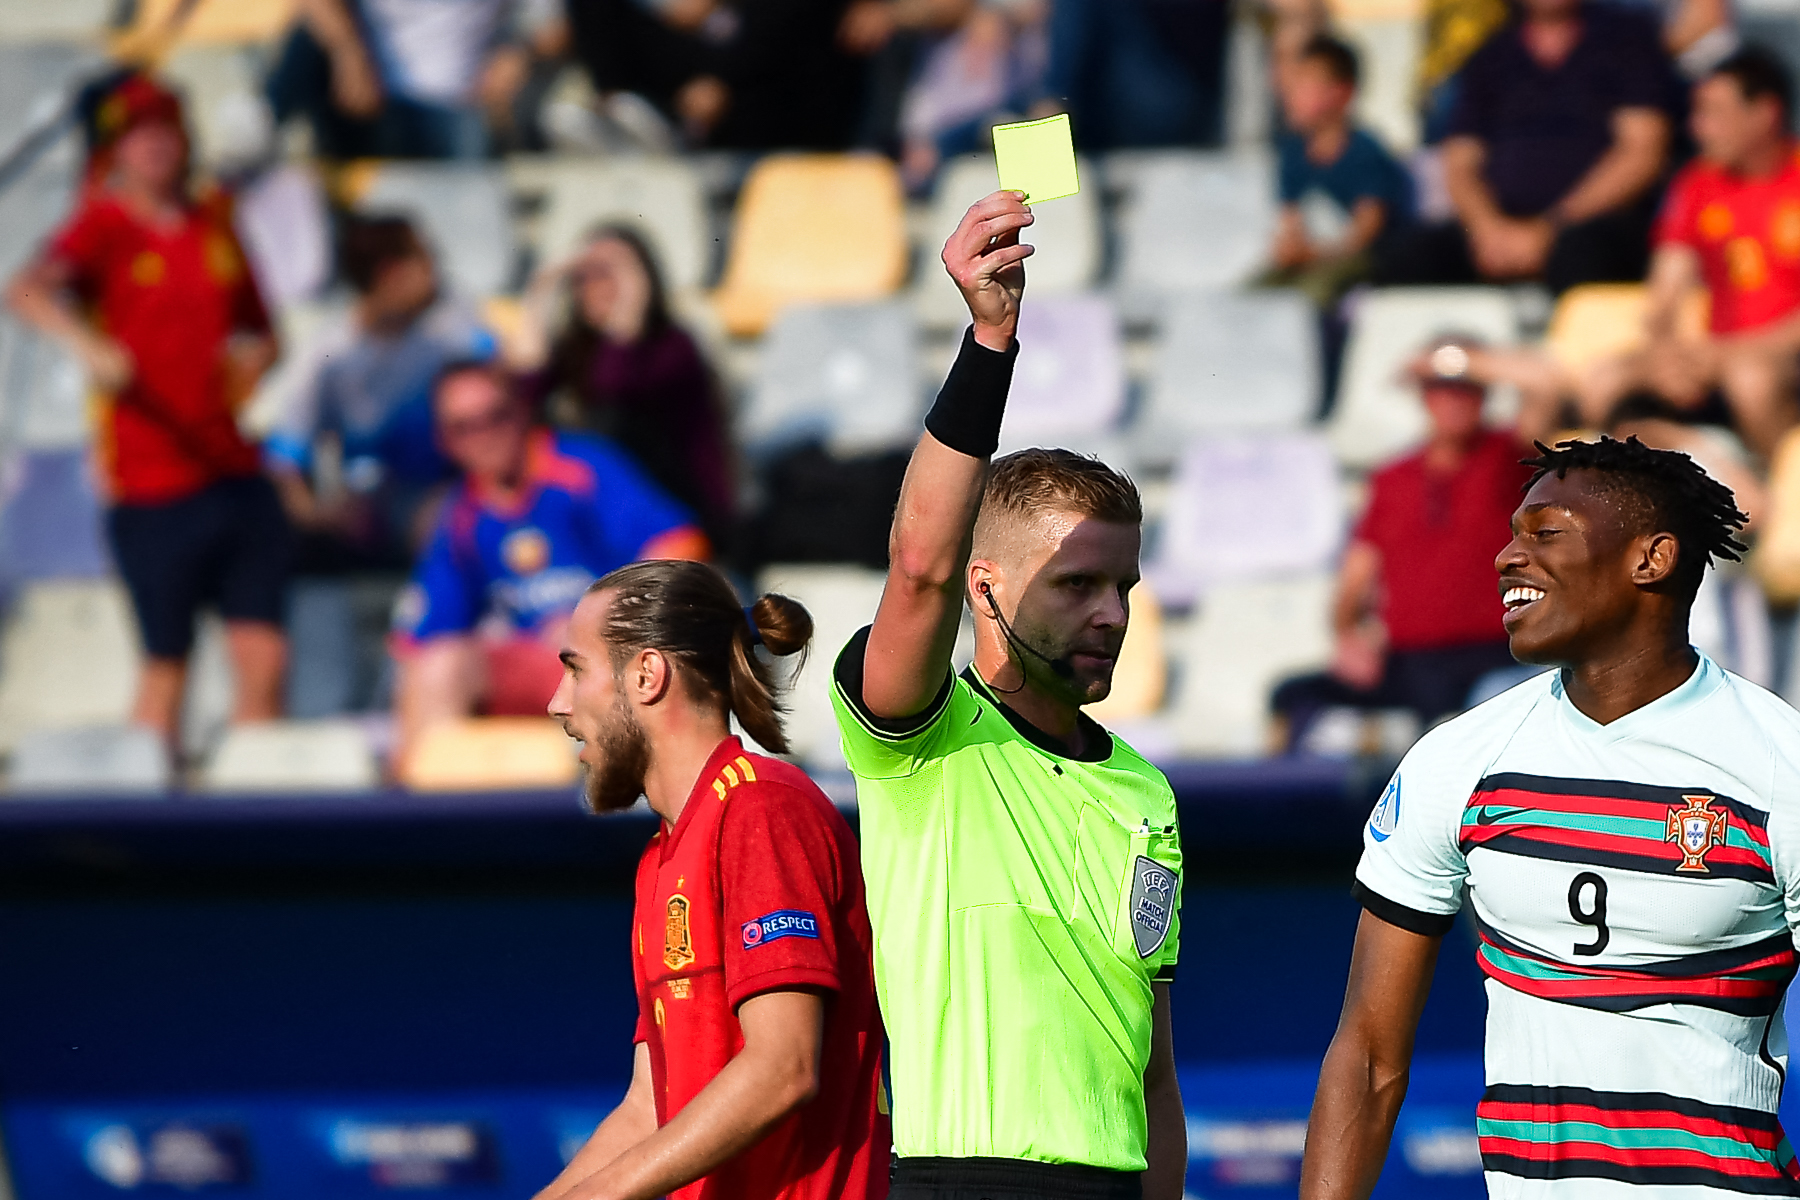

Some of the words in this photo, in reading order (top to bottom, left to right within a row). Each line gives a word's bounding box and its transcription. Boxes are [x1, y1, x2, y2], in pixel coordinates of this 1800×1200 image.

[1138, 896, 1165, 920] MATCH
[1568, 871, 1610, 957] 9
[762, 915, 816, 936] RESPECT
